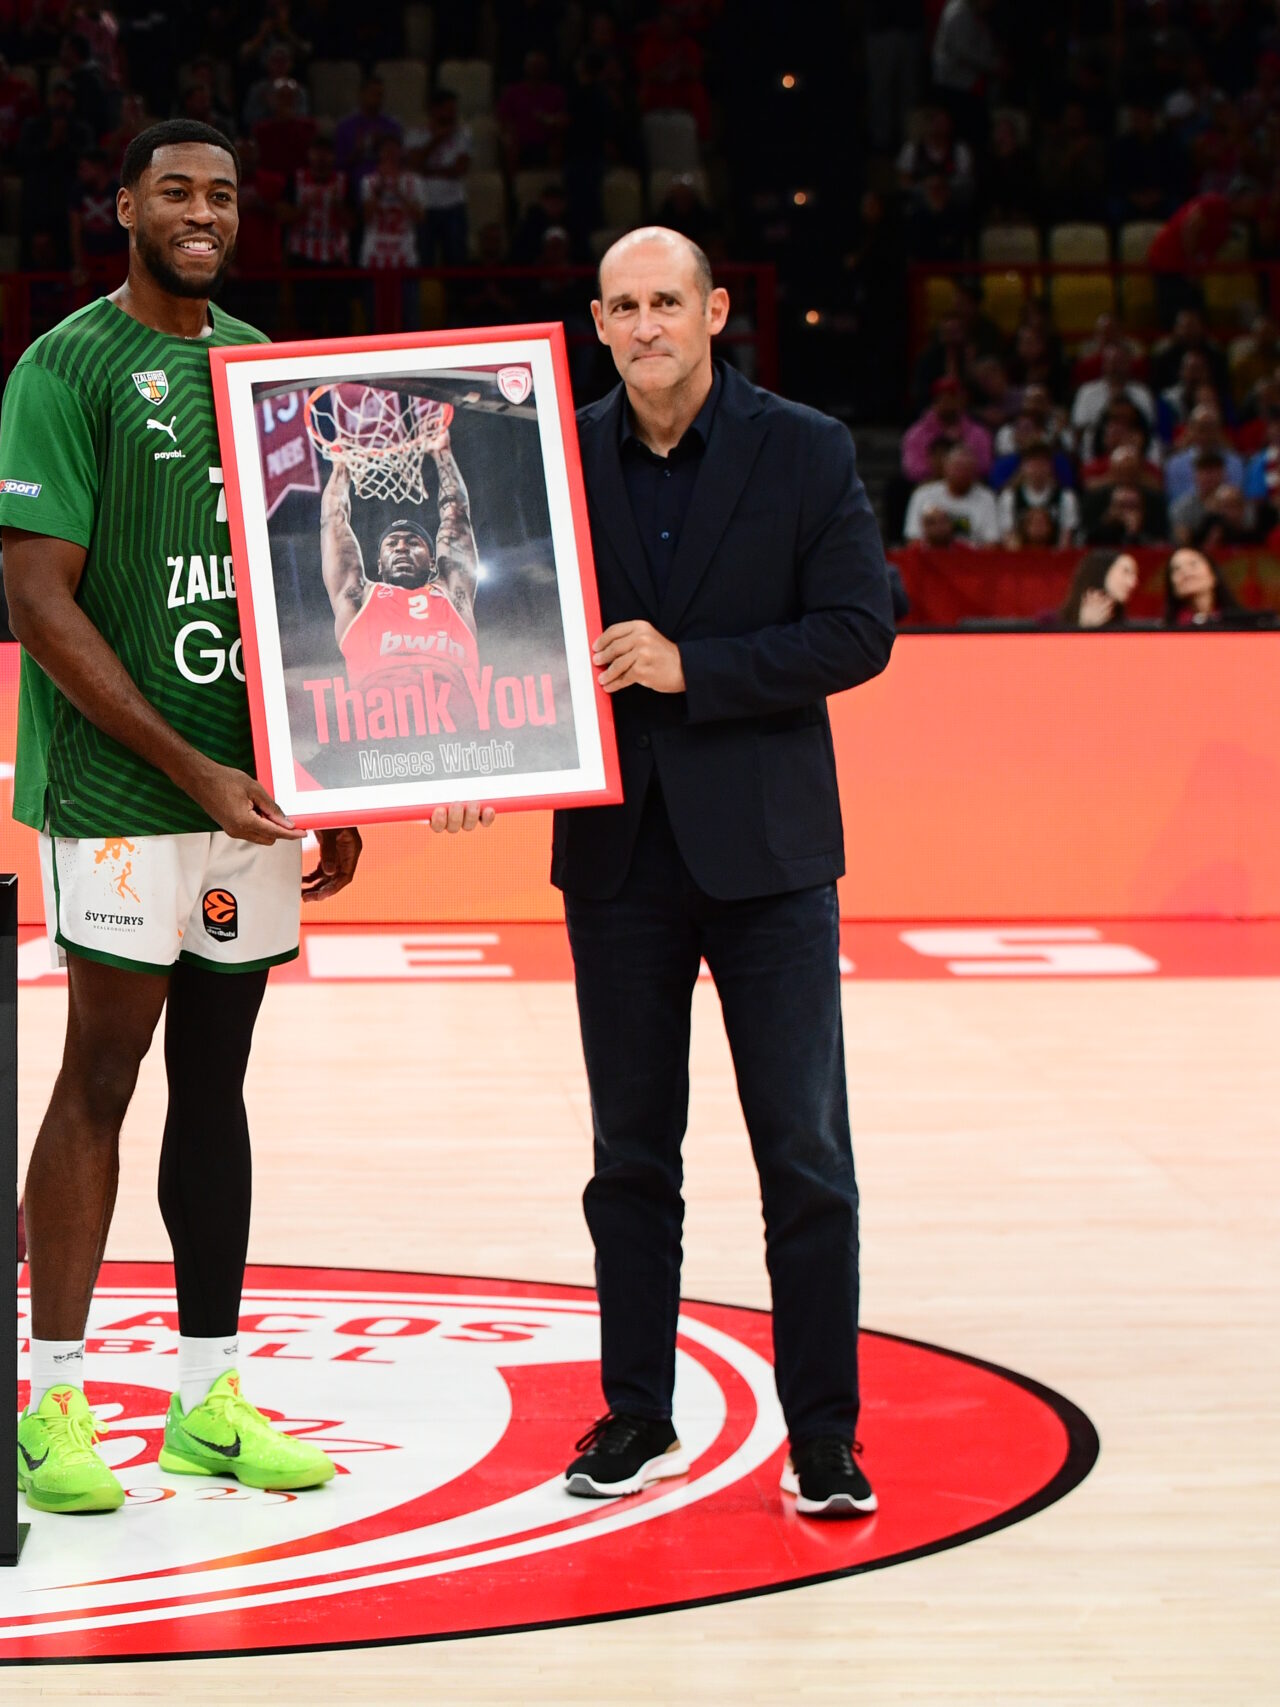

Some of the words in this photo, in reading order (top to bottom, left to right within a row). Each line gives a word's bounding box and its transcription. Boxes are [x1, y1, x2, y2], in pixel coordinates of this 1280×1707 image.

[408, 594, 429, 620] 2
[380, 631, 465, 659] bwin
[303, 669, 457, 744] Thank
[463, 665, 557, 731] You
[359, 751, 435, 780] Moses
[439, 740, 515, 774] Wright
[84, 909, 144, 926] ŠVYTURYS
